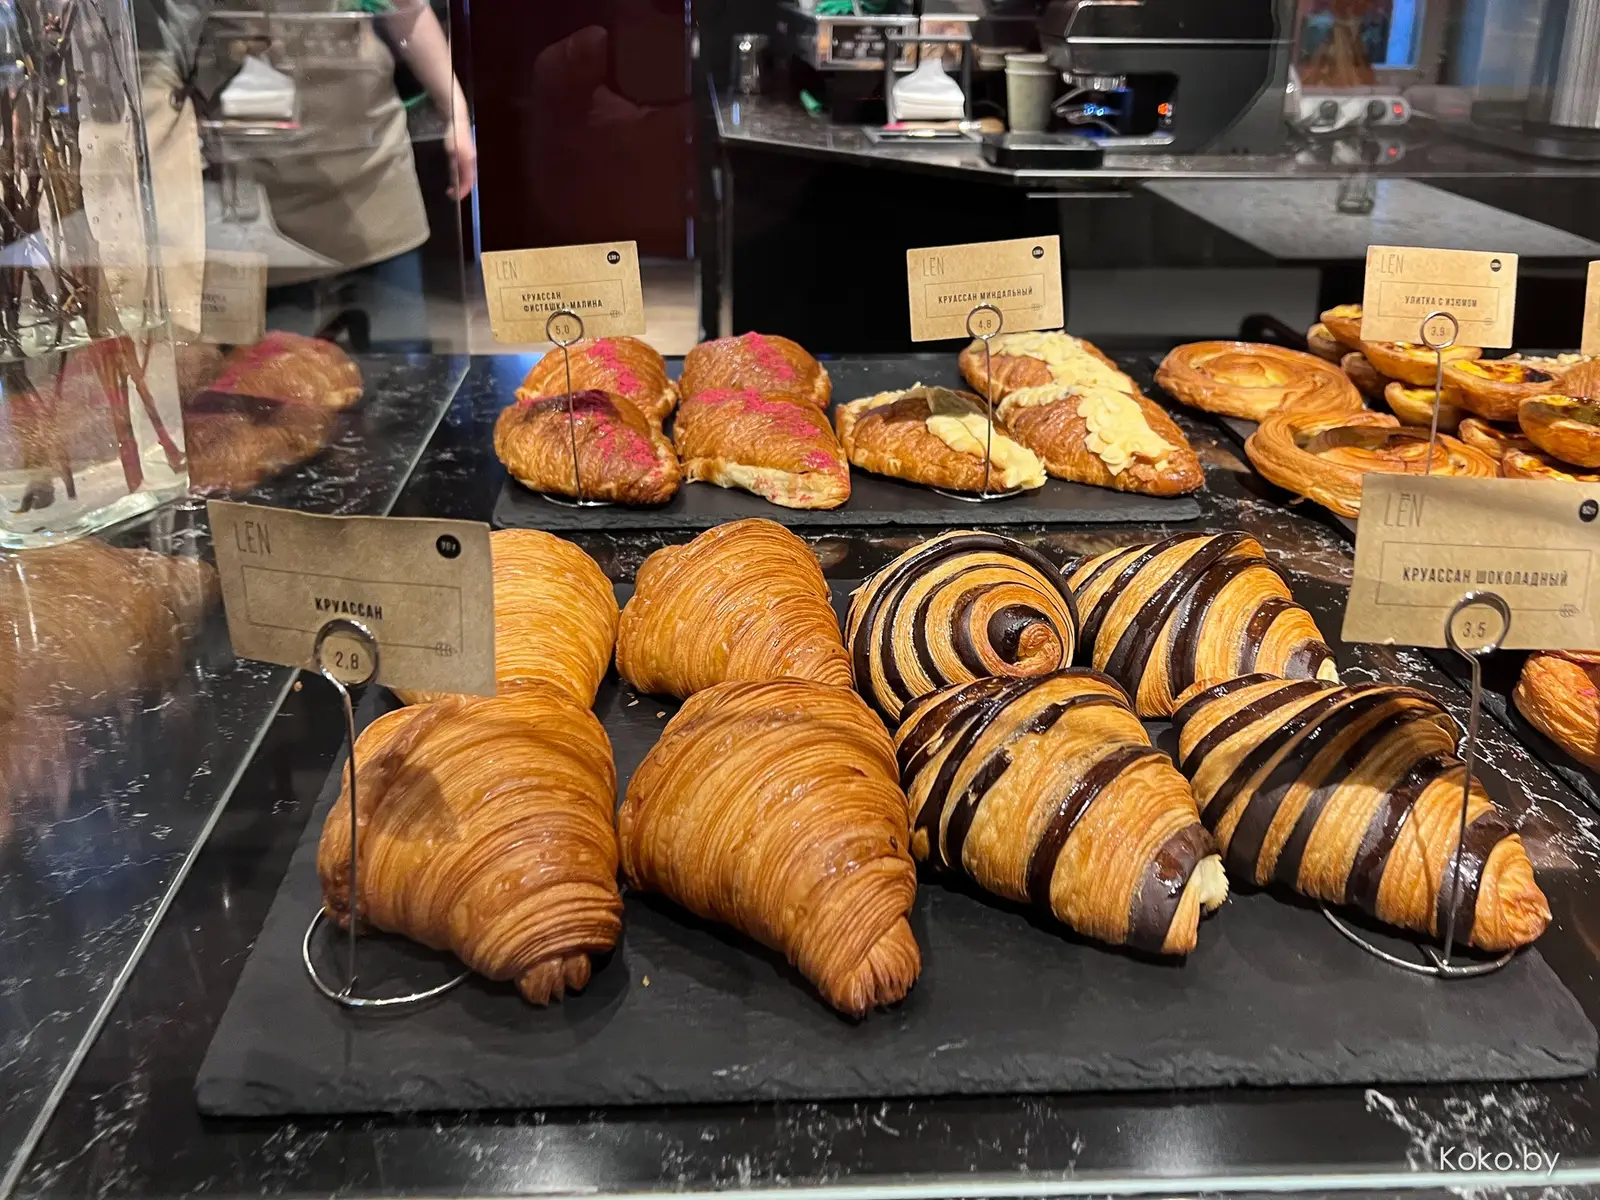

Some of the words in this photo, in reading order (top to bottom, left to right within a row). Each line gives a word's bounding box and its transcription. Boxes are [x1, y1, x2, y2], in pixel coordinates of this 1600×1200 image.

[521, 291, 562, 302] КРУАССАН
[938, 292, 977, 304] КРУАССАН
[979, 286, 1033, 300] МИНДАЛЬНЫЙ
[1404, 295, 1436, 305] УЛИТКА
[1438, 297, 1443, 306] С
[1444, 298, 1477, 307] ИЗЮМОМ
[1402, 566, 1471, 584] КРУАССАН
[1476, 569, 1569, 587] ШОКОЛАДНЫЙ
[314, 597, 383, 620] КРУАССАН
